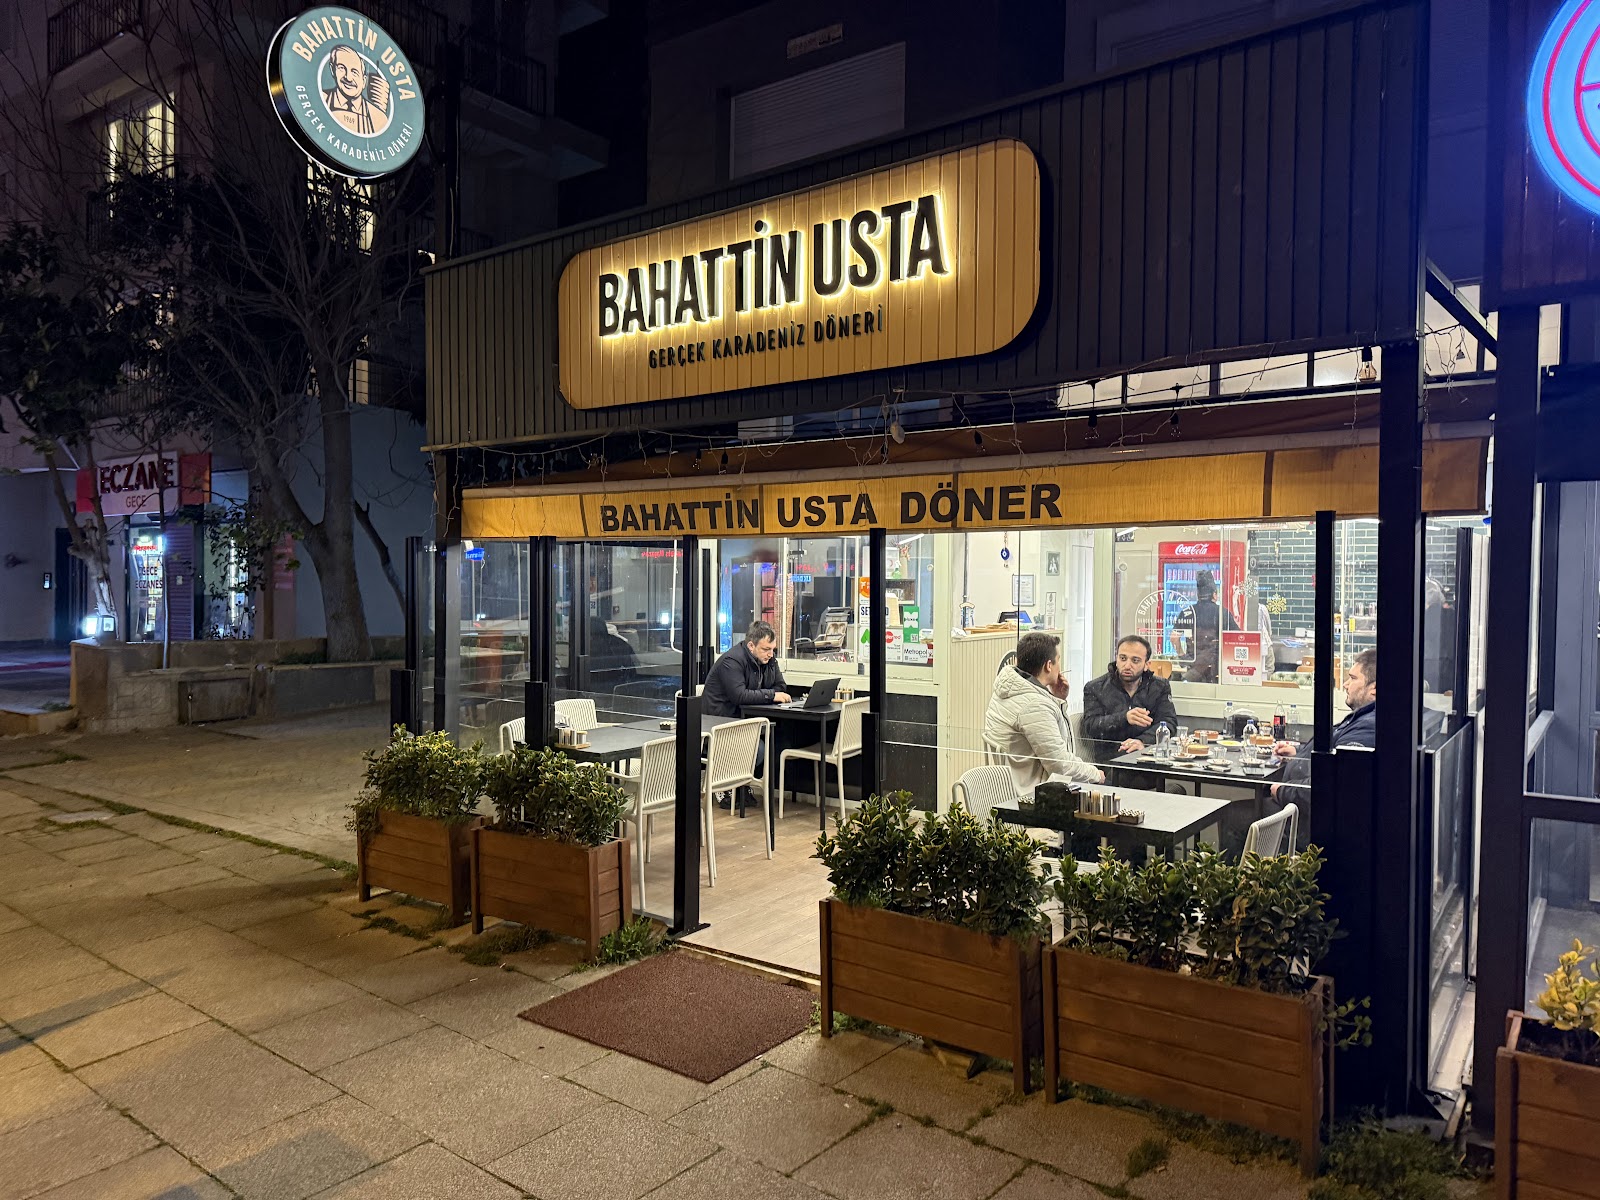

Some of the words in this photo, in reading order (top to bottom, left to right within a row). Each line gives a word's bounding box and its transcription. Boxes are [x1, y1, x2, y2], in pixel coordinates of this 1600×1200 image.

[292, 15, 379, 63] BAHATTİN
[380, 46, 417, 101] USTA
[295, 84, 326, 134] GERÇEK
[326, 132, 387, 162] KARADENİZ
[389, 122, 414, 157] DÖNERİ
[343, 114, 356, 125] 1969
[598, 219, 803, 338] BAHATTİN
[813, 194, 950, 298] USTA
[648, 341, 706, 369] GERÇEK
[712, 320, 806, 360] KARADENİZ
[814, 303, 884, 343] DÖNERİ
[100, 458, 174, 494] ECZANE
[125, 495, 147, 508] GECE
[601, 493, 759, 533] BAHATTİN
[777, 493, 877, 528] USTA
[900, 481, 1063, 525] DÖNER
[1137, 592, 1174, 616] BAHATTN
[904, 648, 928, 656] Metropol
